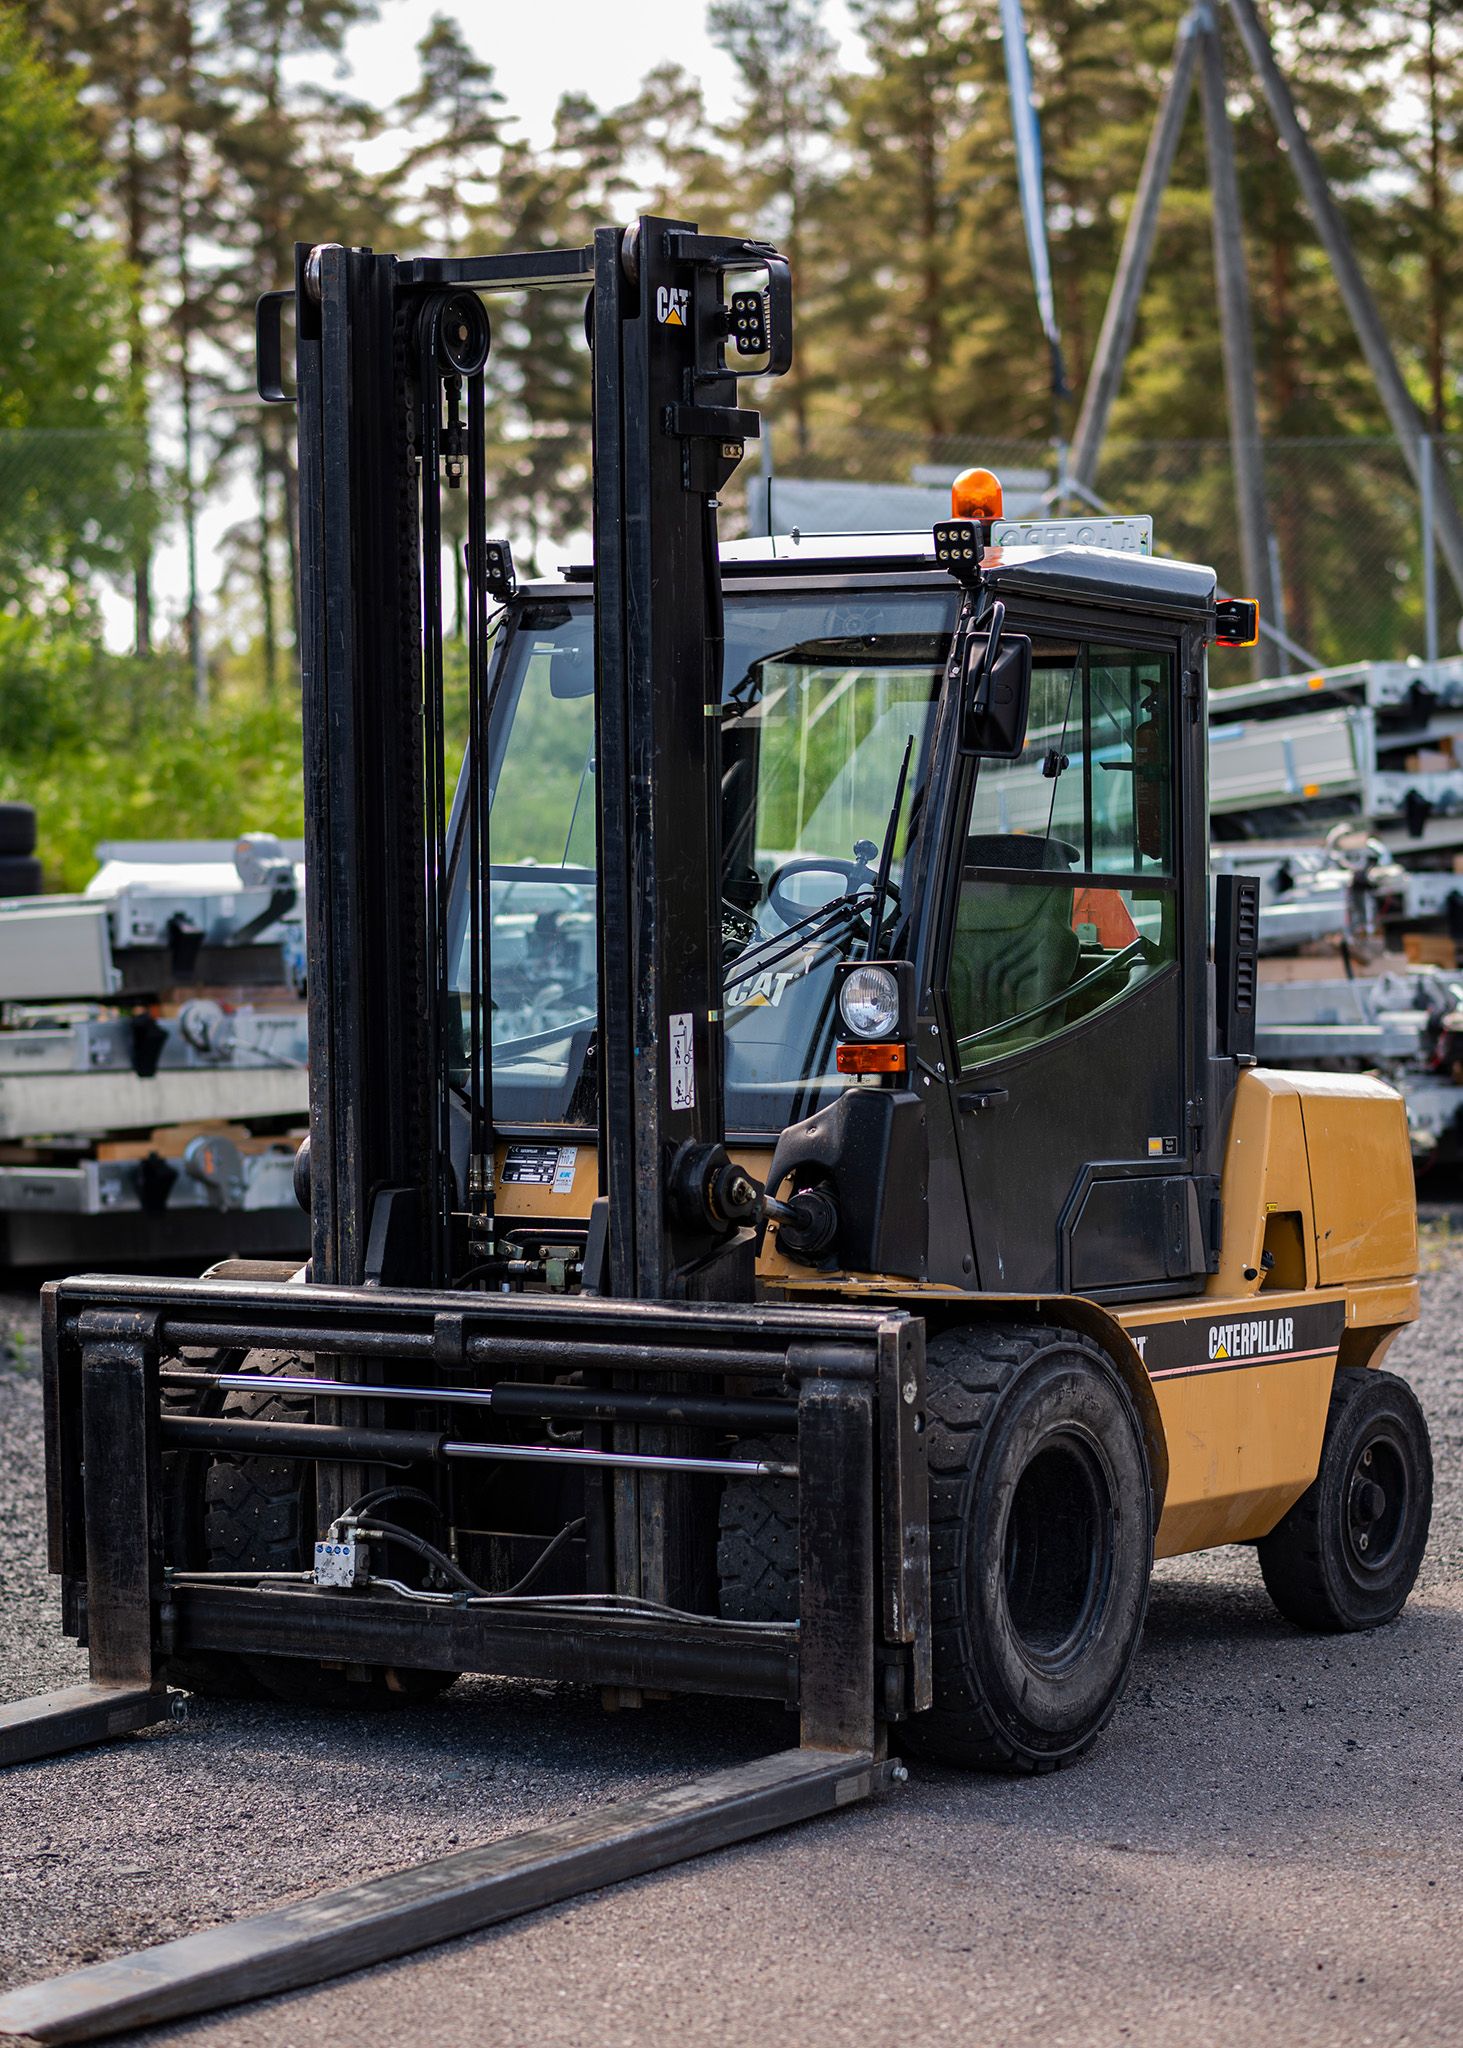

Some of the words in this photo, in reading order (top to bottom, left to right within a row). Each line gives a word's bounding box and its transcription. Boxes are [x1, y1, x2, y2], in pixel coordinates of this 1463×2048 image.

[657, 286, 689, 326] CAT
[728, 973, 794, 1007] CAT
[1208, 1317, 1294, 1360] CATERPILLAR
